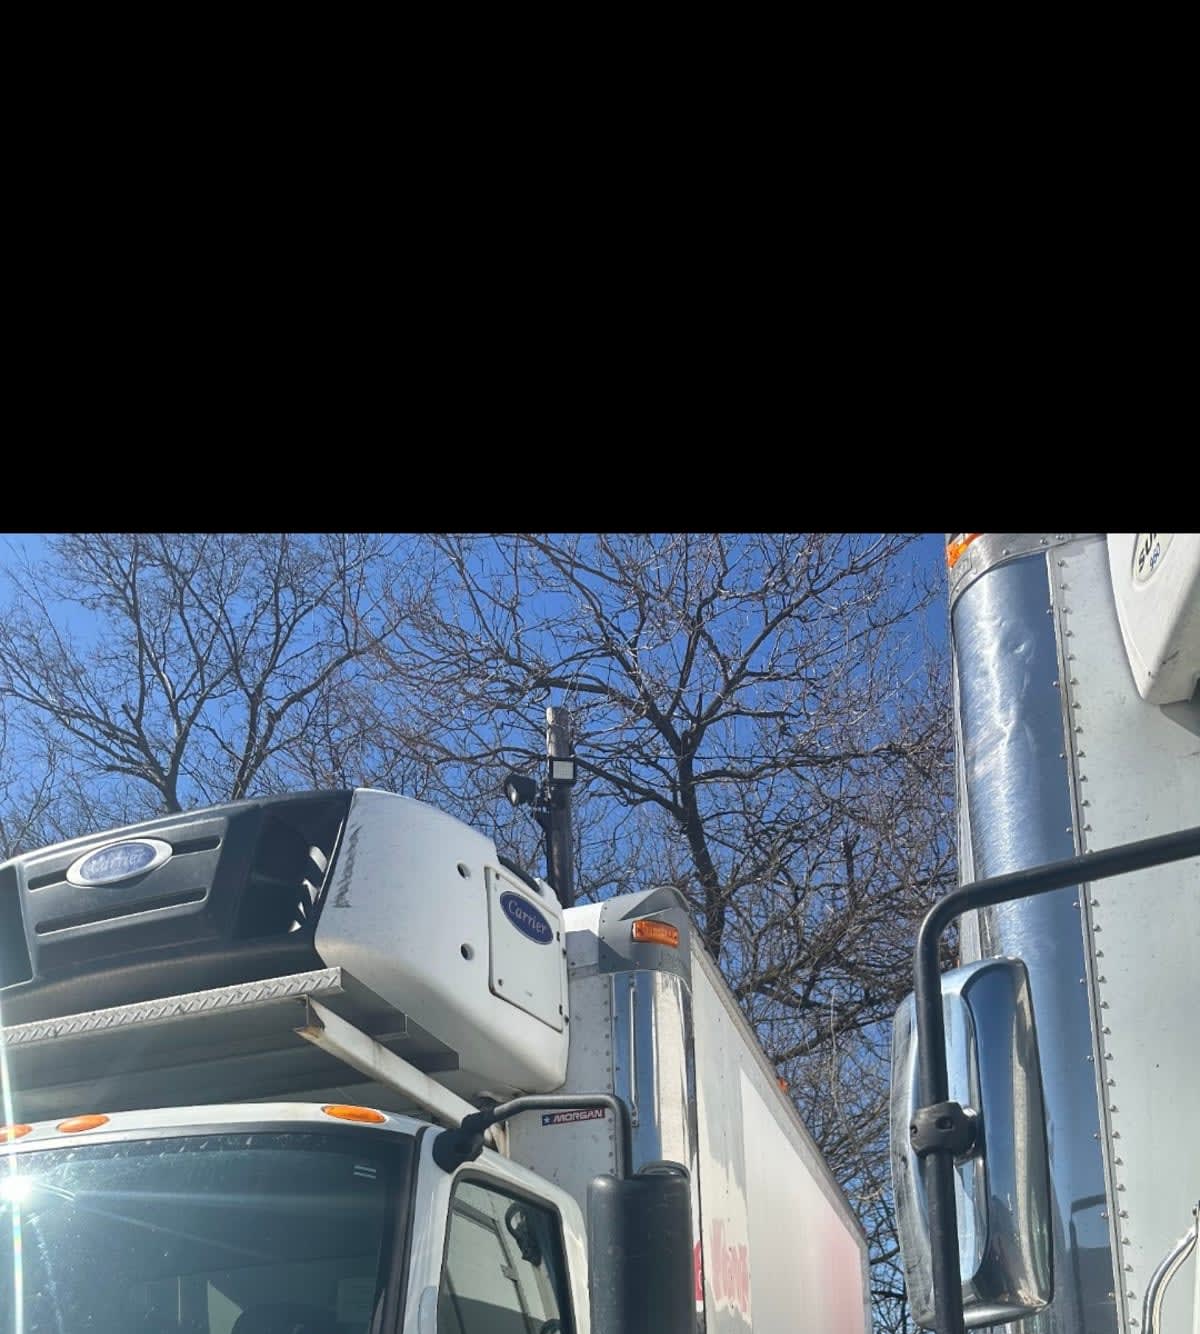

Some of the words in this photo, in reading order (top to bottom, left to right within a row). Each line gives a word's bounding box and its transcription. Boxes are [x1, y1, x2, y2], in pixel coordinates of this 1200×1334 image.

[1138, 533, 1157, 574] SU
[508, 899, 547, 935] Carrier
[553, 1108, 603, 1123] MORGAN
